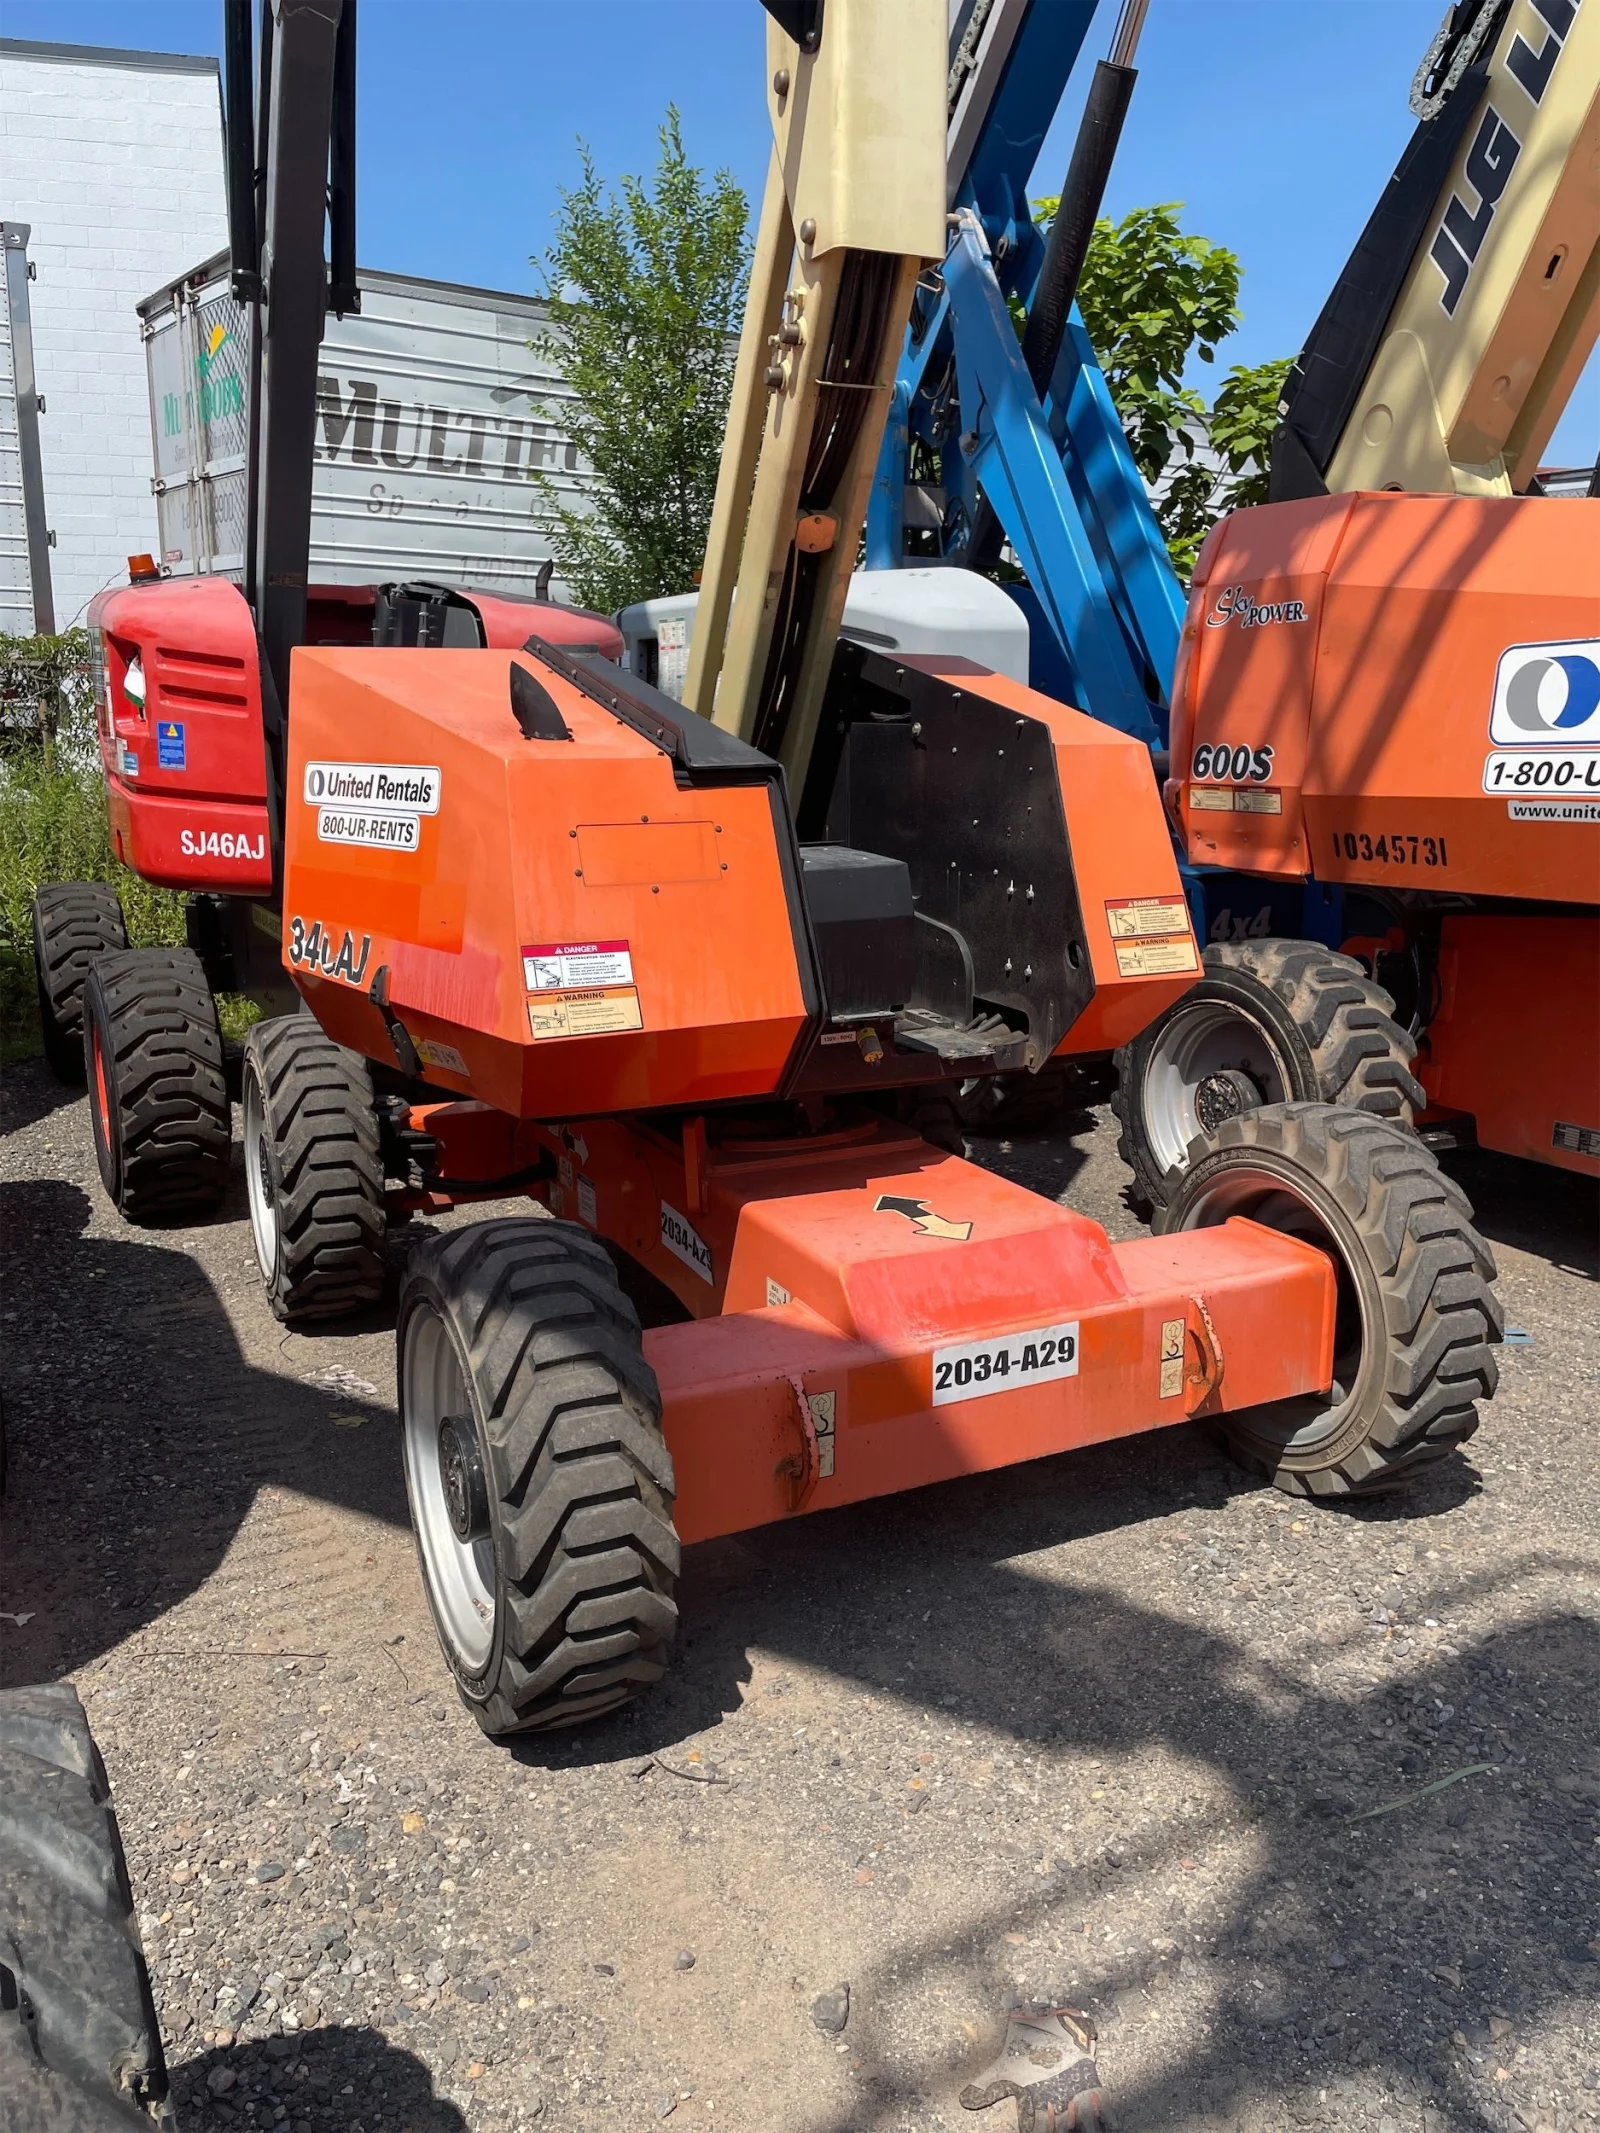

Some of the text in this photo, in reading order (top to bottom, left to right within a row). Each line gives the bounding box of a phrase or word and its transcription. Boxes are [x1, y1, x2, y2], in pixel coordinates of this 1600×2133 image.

[1428, 101, 1523, 321] JLG
[1193, 744, 1274, 782] 600S
[328, 772, 431, 803] United Rentals
[180, 829, 265, 860] SJ46AJ
[323, 815, 414, 843] 800-UR-RENTS
[1332, 832, 1447, 867] 10345731
[1133, 899, 1159, 907] DANGER
[563, 945, 598, 954] DANGER
[1140, 937, 1170, 946] WARNING
[564, 992, 605, 1001] WARNING
[935, 1336, 1075, 1391] 2034-A29
